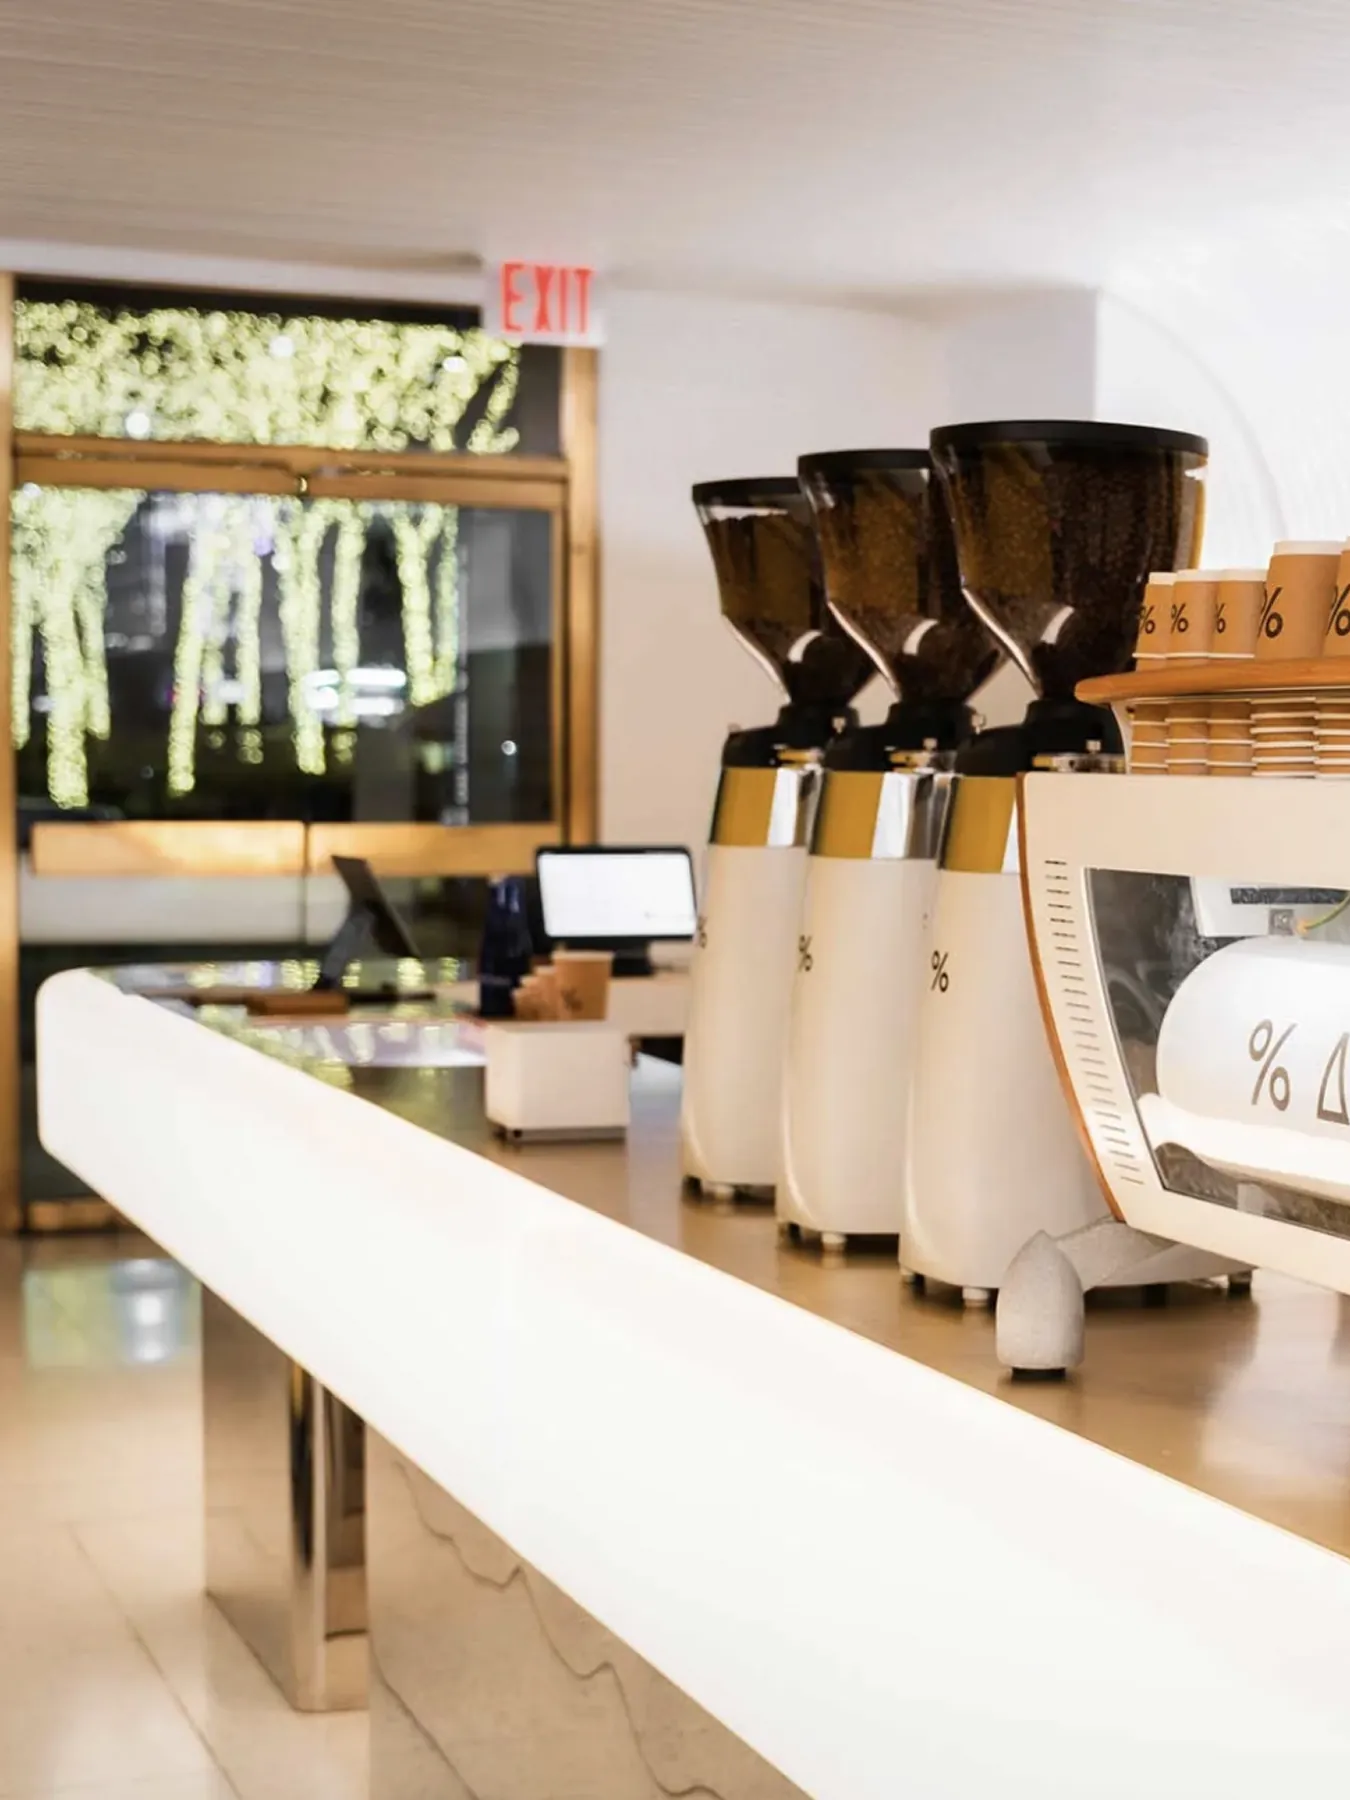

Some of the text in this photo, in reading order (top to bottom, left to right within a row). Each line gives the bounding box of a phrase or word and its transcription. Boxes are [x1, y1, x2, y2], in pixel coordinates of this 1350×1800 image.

[501, 262, 594, 333] EXIT
[931, 950, 949, 993] %
[1248, 1019, 1298, 1112] %
